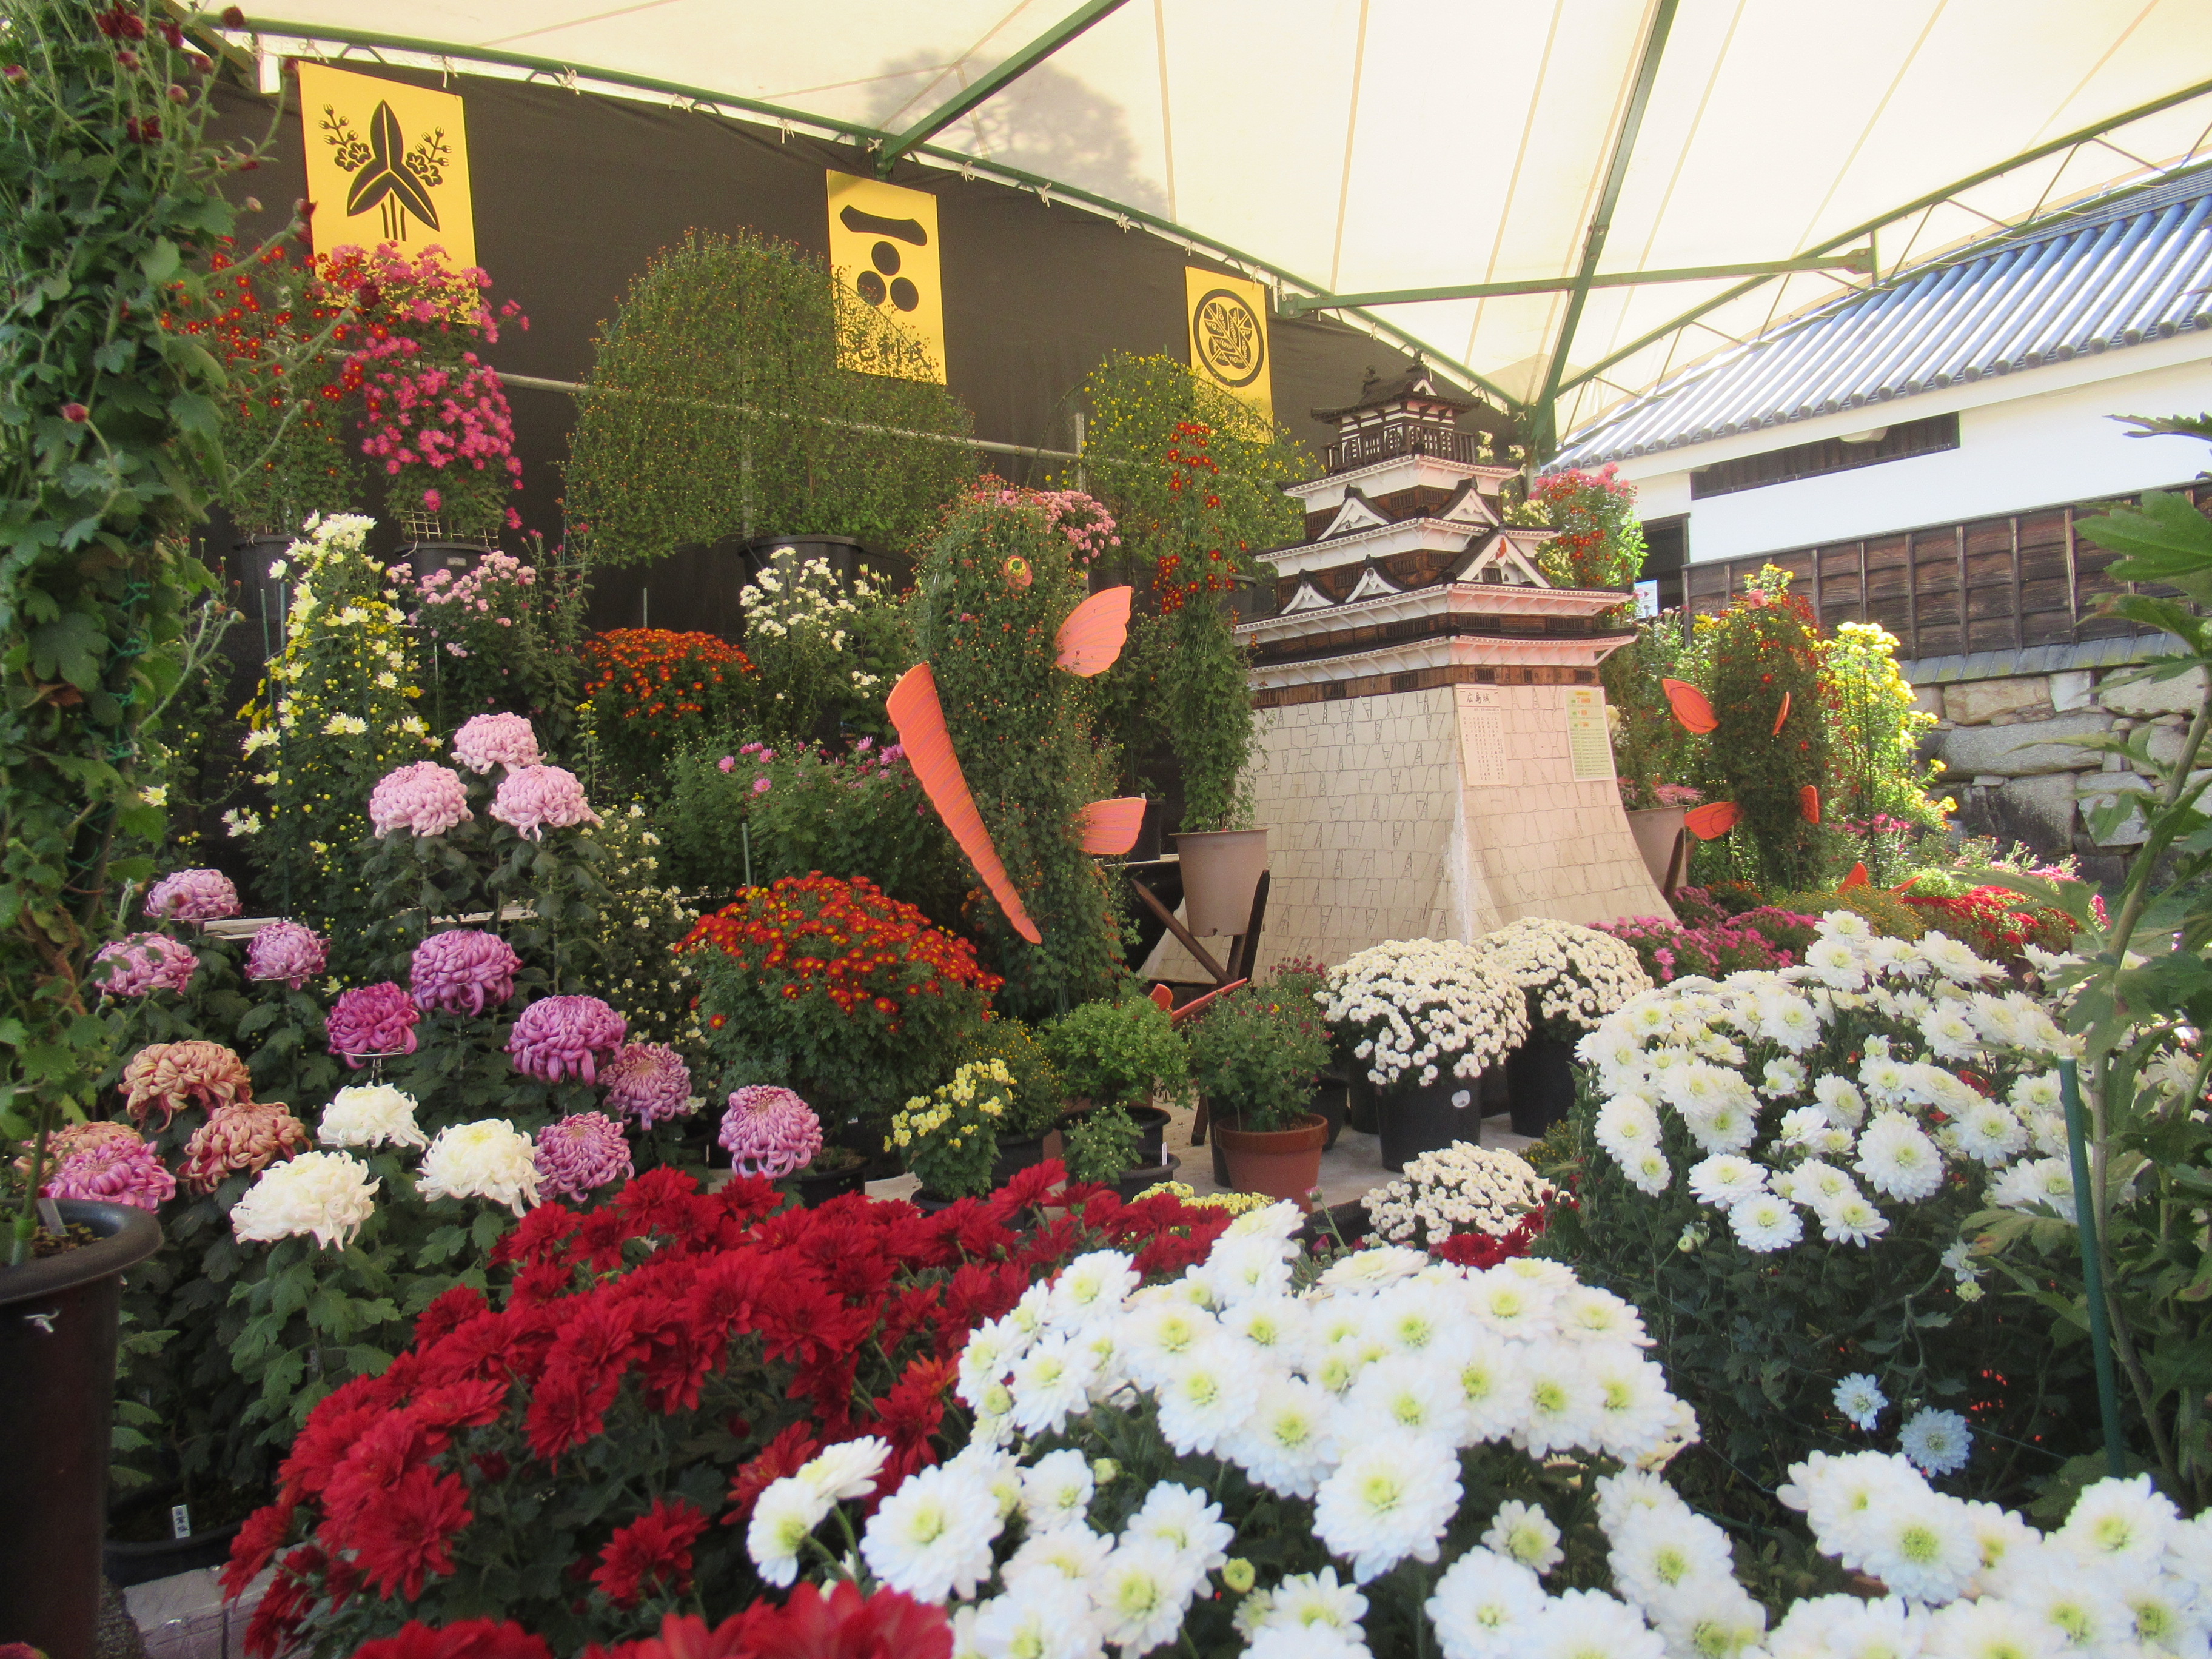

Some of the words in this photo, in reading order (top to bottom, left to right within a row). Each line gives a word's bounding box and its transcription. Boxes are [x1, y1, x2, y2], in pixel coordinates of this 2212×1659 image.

[850, 330, 932, 369] 毛利氏
[1466, 692, 1491, 704] 広島城
